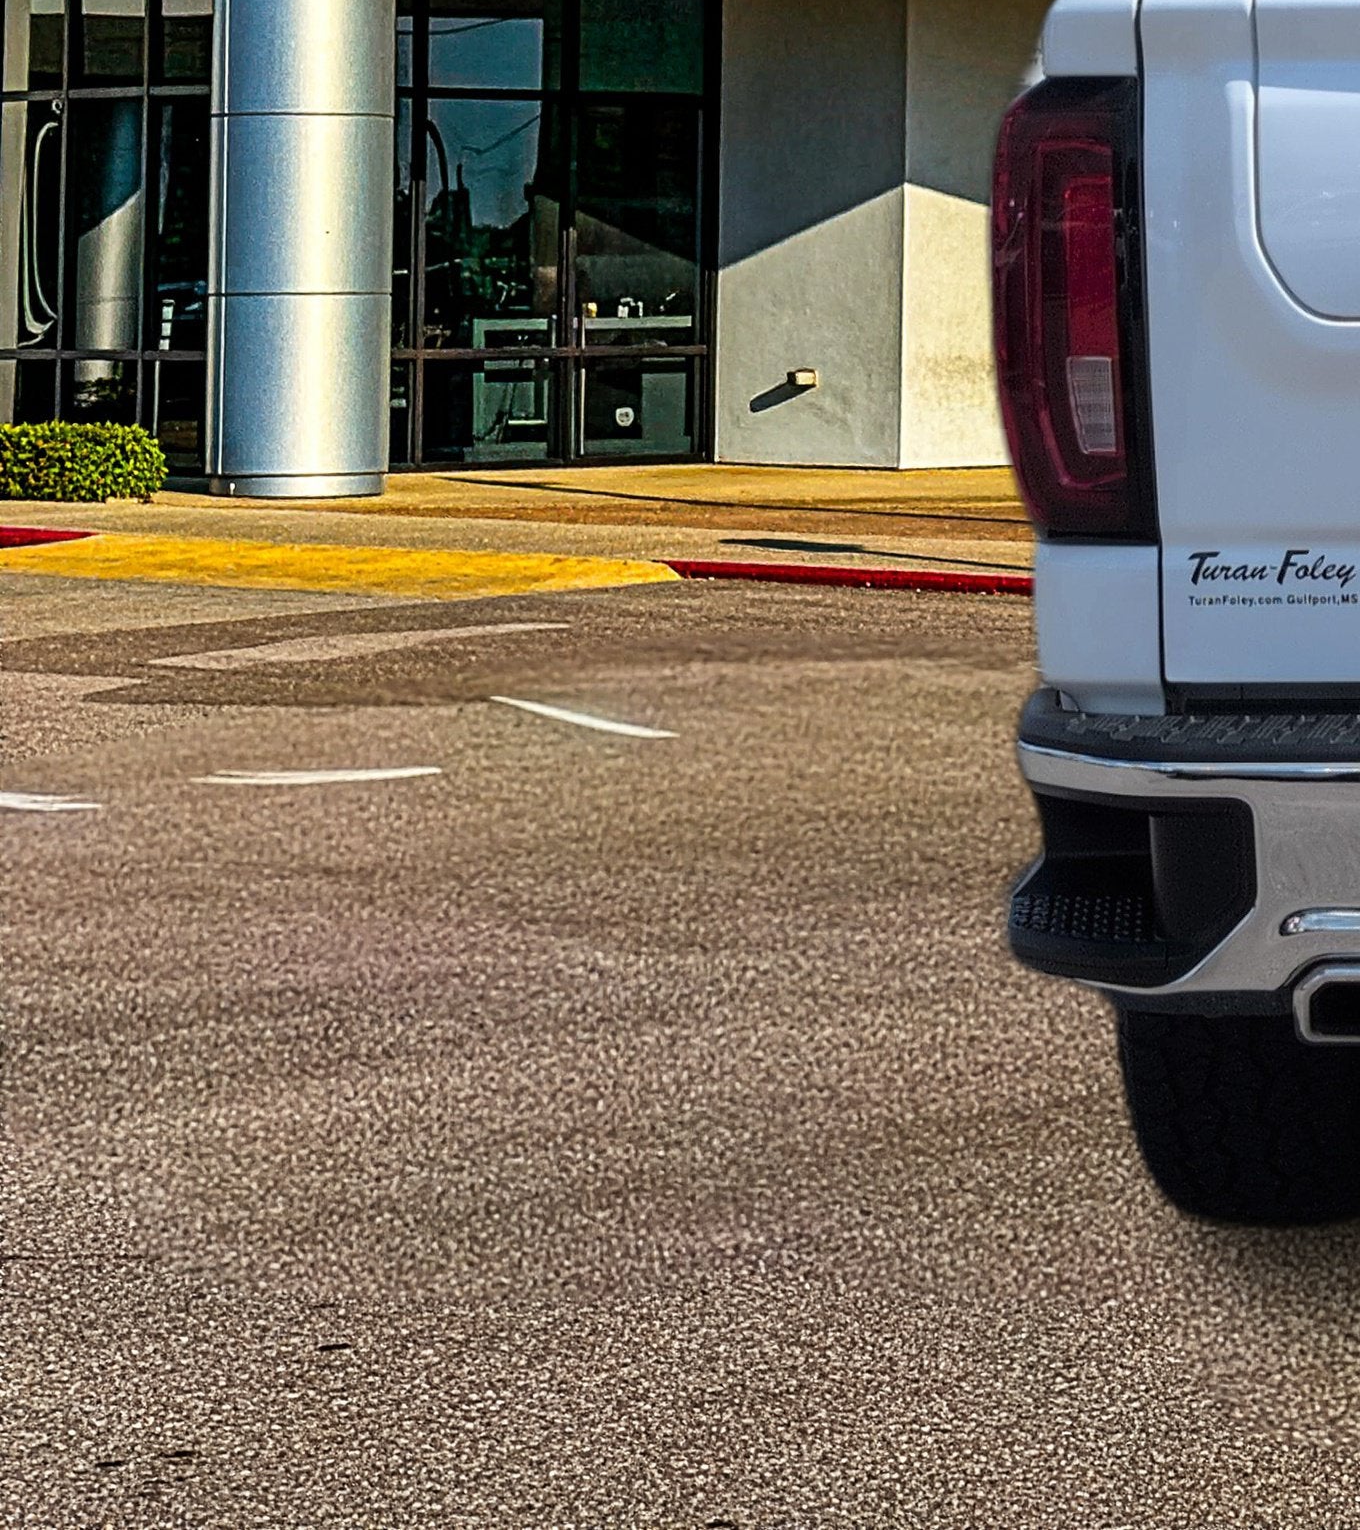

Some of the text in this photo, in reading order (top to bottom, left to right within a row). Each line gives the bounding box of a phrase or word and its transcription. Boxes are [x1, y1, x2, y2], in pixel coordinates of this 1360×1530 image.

[1188, 549, 1356, 588] Turan Foley
[1188, 595, 1283, 607] TuranFoley.com
